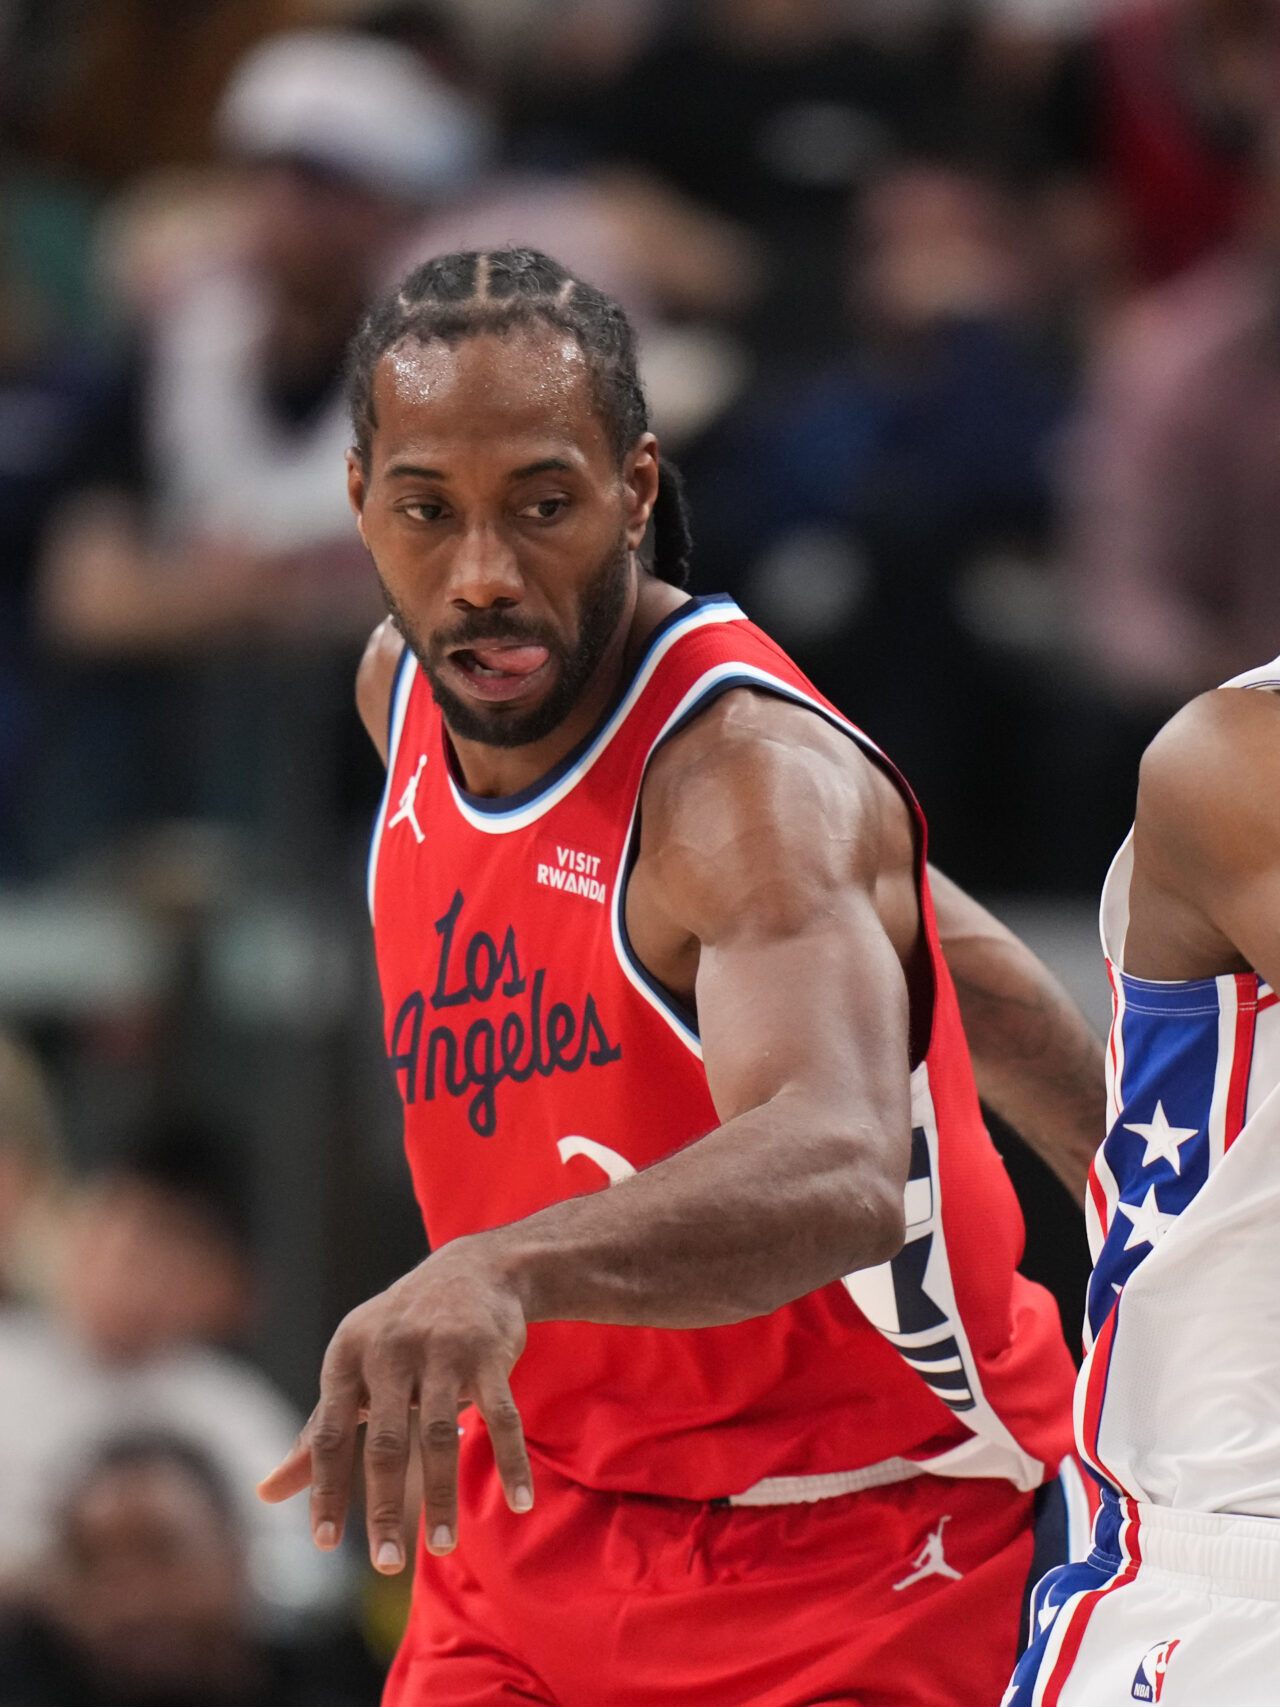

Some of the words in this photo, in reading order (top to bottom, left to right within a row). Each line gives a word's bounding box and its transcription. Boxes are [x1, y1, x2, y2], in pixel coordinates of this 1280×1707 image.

[556, 845, 602, 877] VISIT
[537, 863, 606, 905] RWANDA
[430, 889, 526, 1010] Los
[388, 968, 622, 1138] Angeles
[1134, 1683, 1150, 1699] NBA
